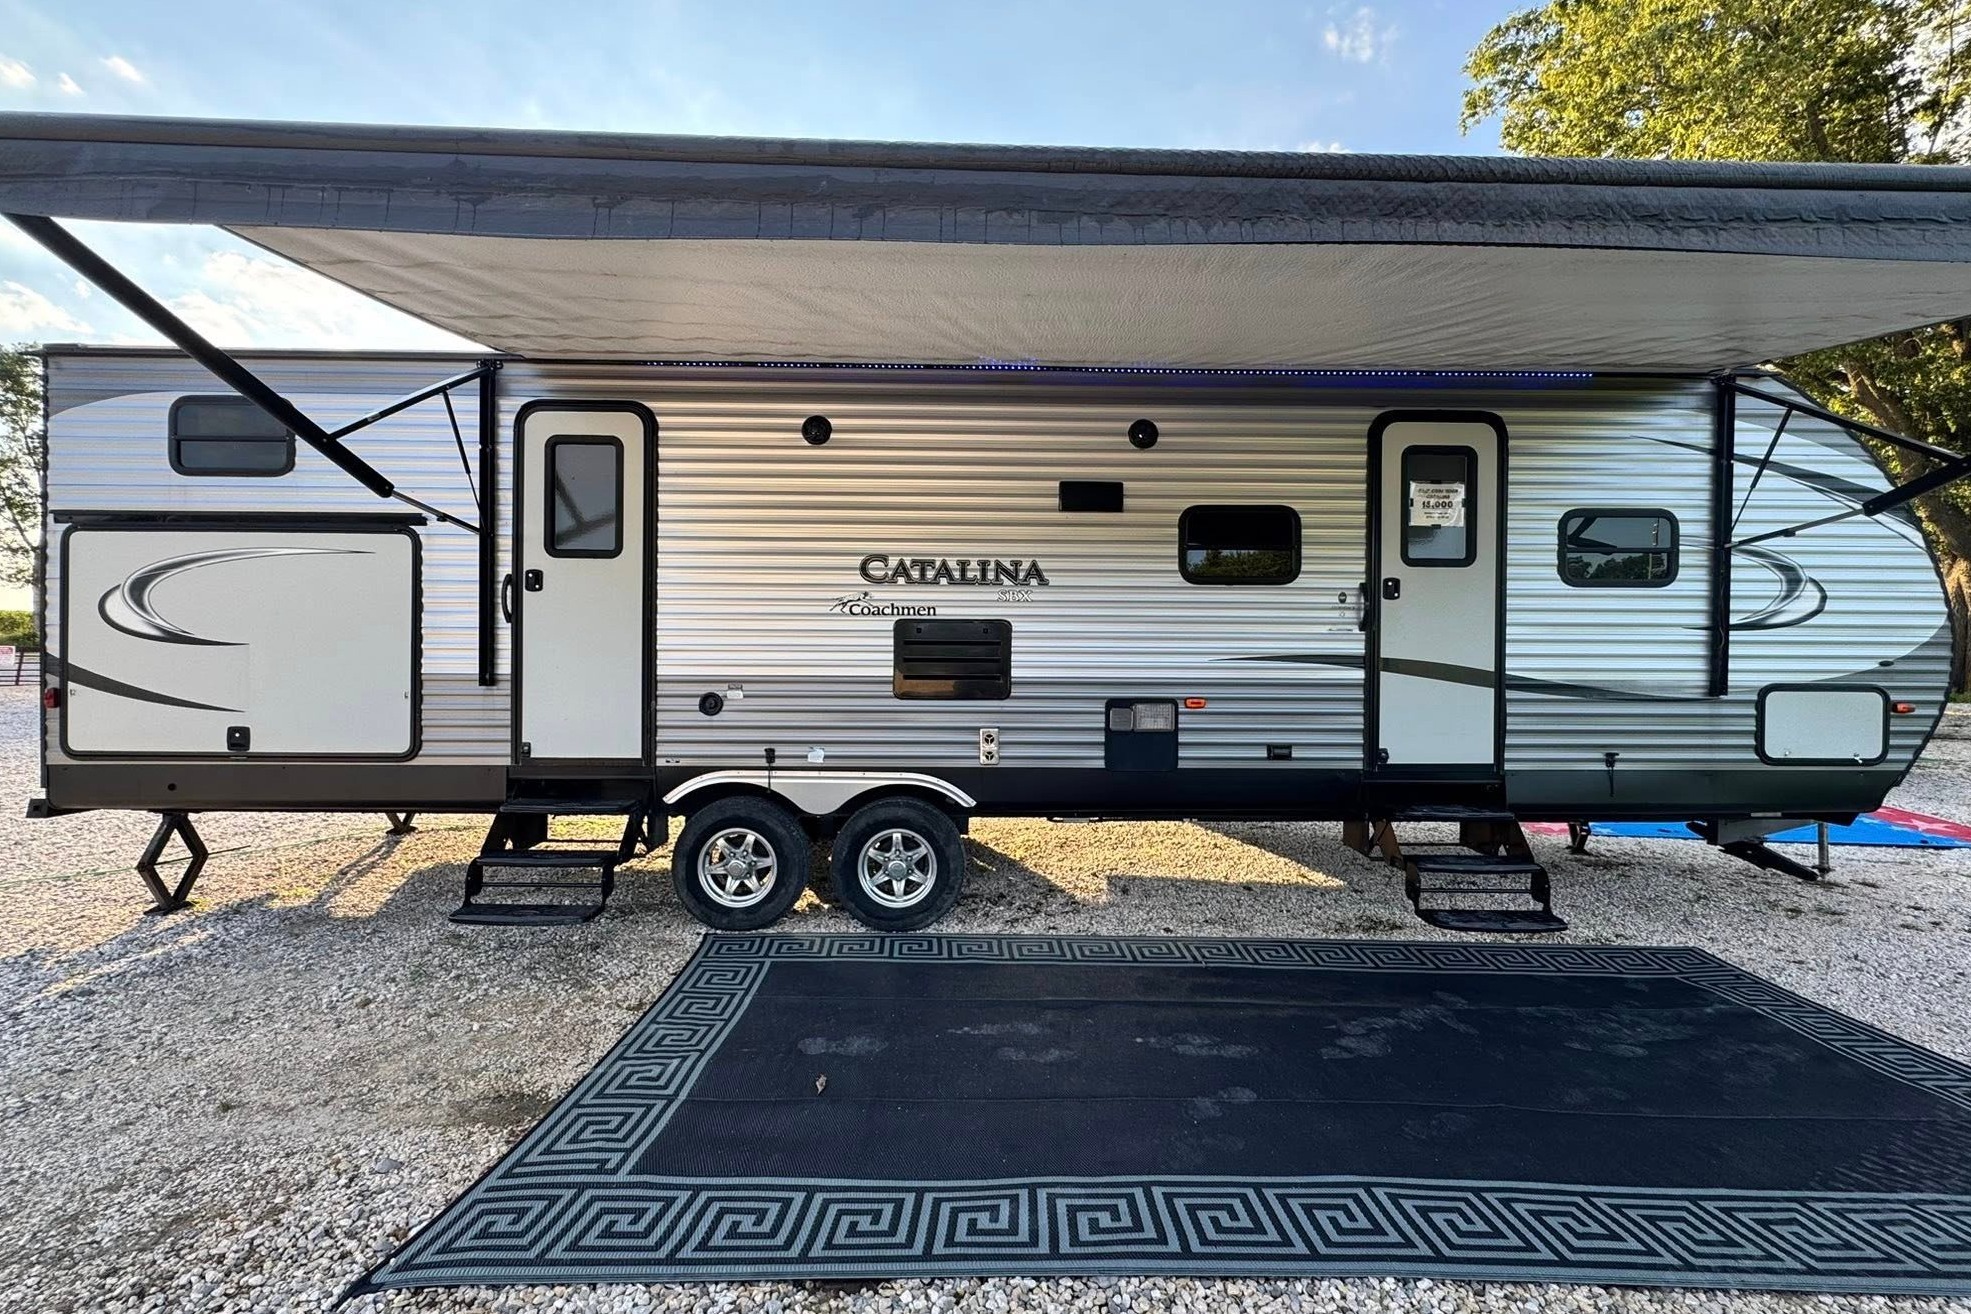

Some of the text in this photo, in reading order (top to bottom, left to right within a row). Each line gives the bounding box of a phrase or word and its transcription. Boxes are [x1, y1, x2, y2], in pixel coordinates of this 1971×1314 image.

[859, 554, 1049, 585] CATALINA
[996, 588, 1033, 602] SBX
[849, 602, 937, 616] Coachmen
